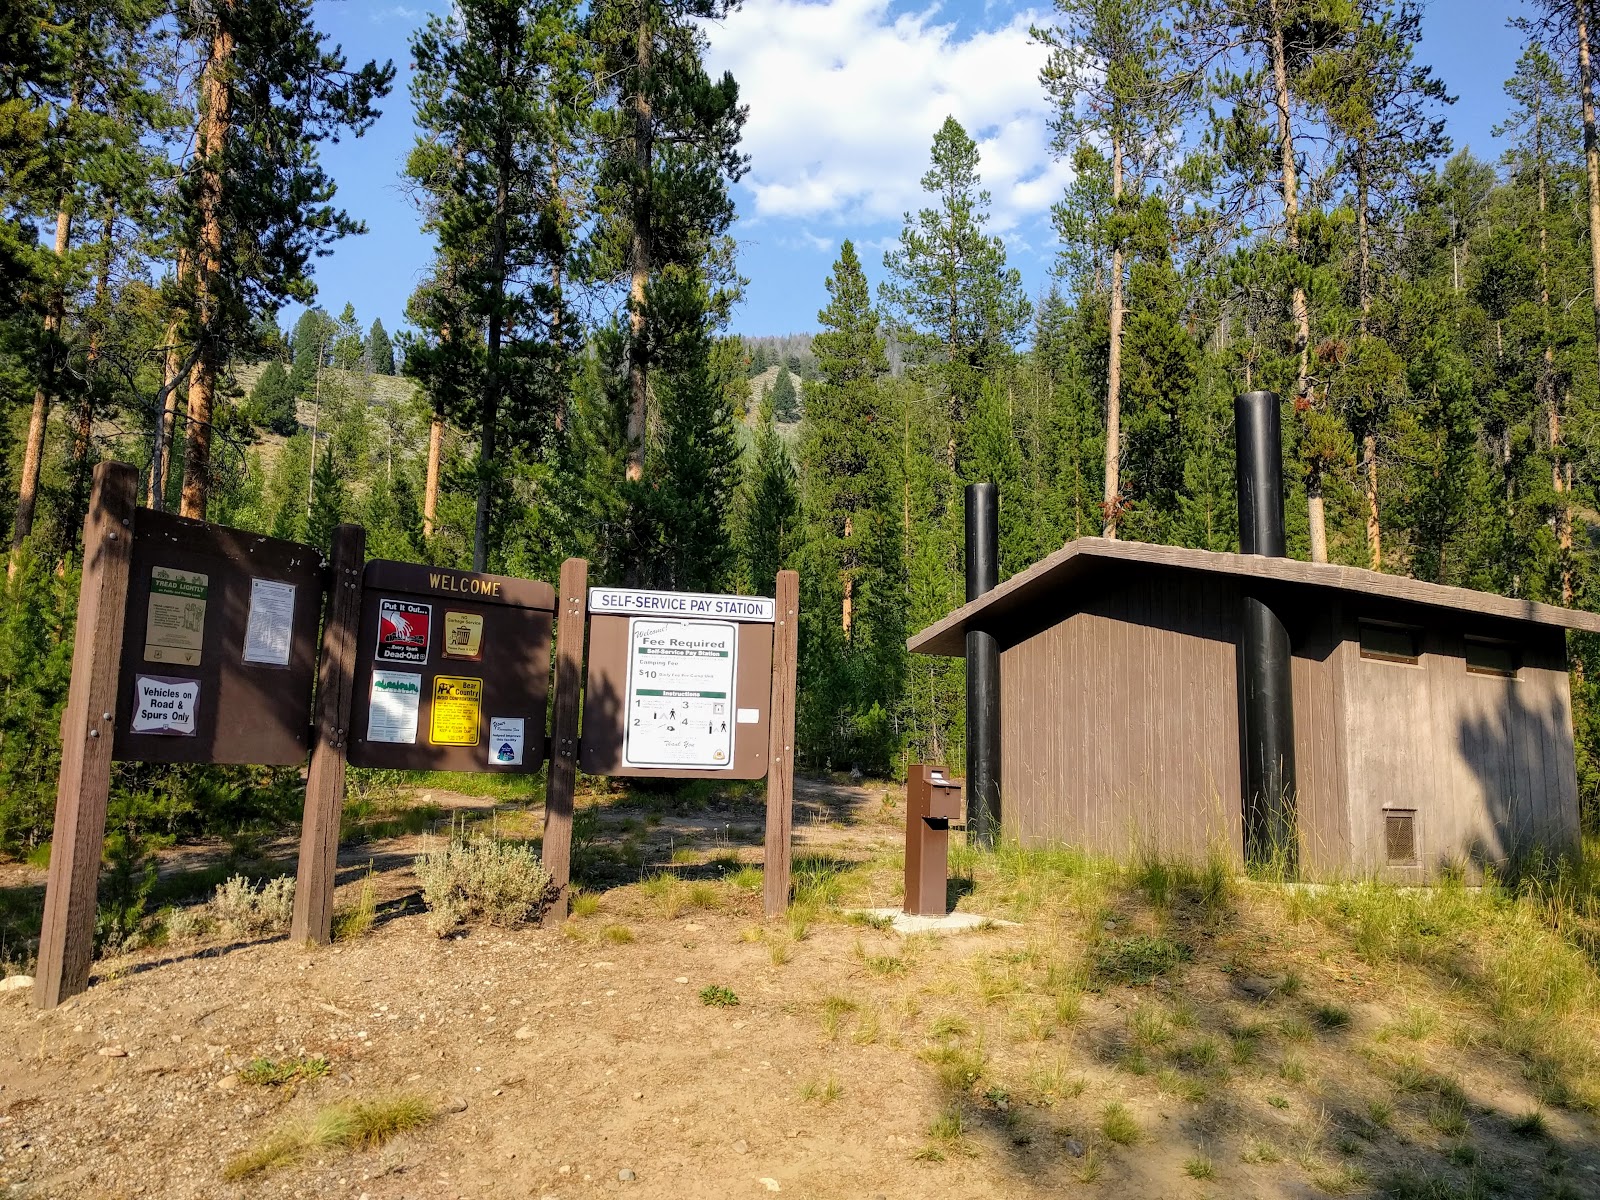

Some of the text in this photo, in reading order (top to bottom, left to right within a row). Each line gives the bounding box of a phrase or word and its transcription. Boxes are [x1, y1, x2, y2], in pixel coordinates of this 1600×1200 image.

[155, 580, 204, 592] TREAD LIGHTLY
[430, 573, 500, 596] WELCOME
[602, 594, 763, 615] SELF-SERVICE PAY STATION
[634, 624, 668, 638] Welcome!
[642, 638, 724, 648] Fee Required
[384, 650, 420, 660] Dead-Out
[639, 670, 656, 678] $10
[144, 686, 180, 698] Vehicles
[456, 689, 478, 697] Country
[150, 698, 184, 710] Road &
[142, 710, 190, 722] Spurs Only
